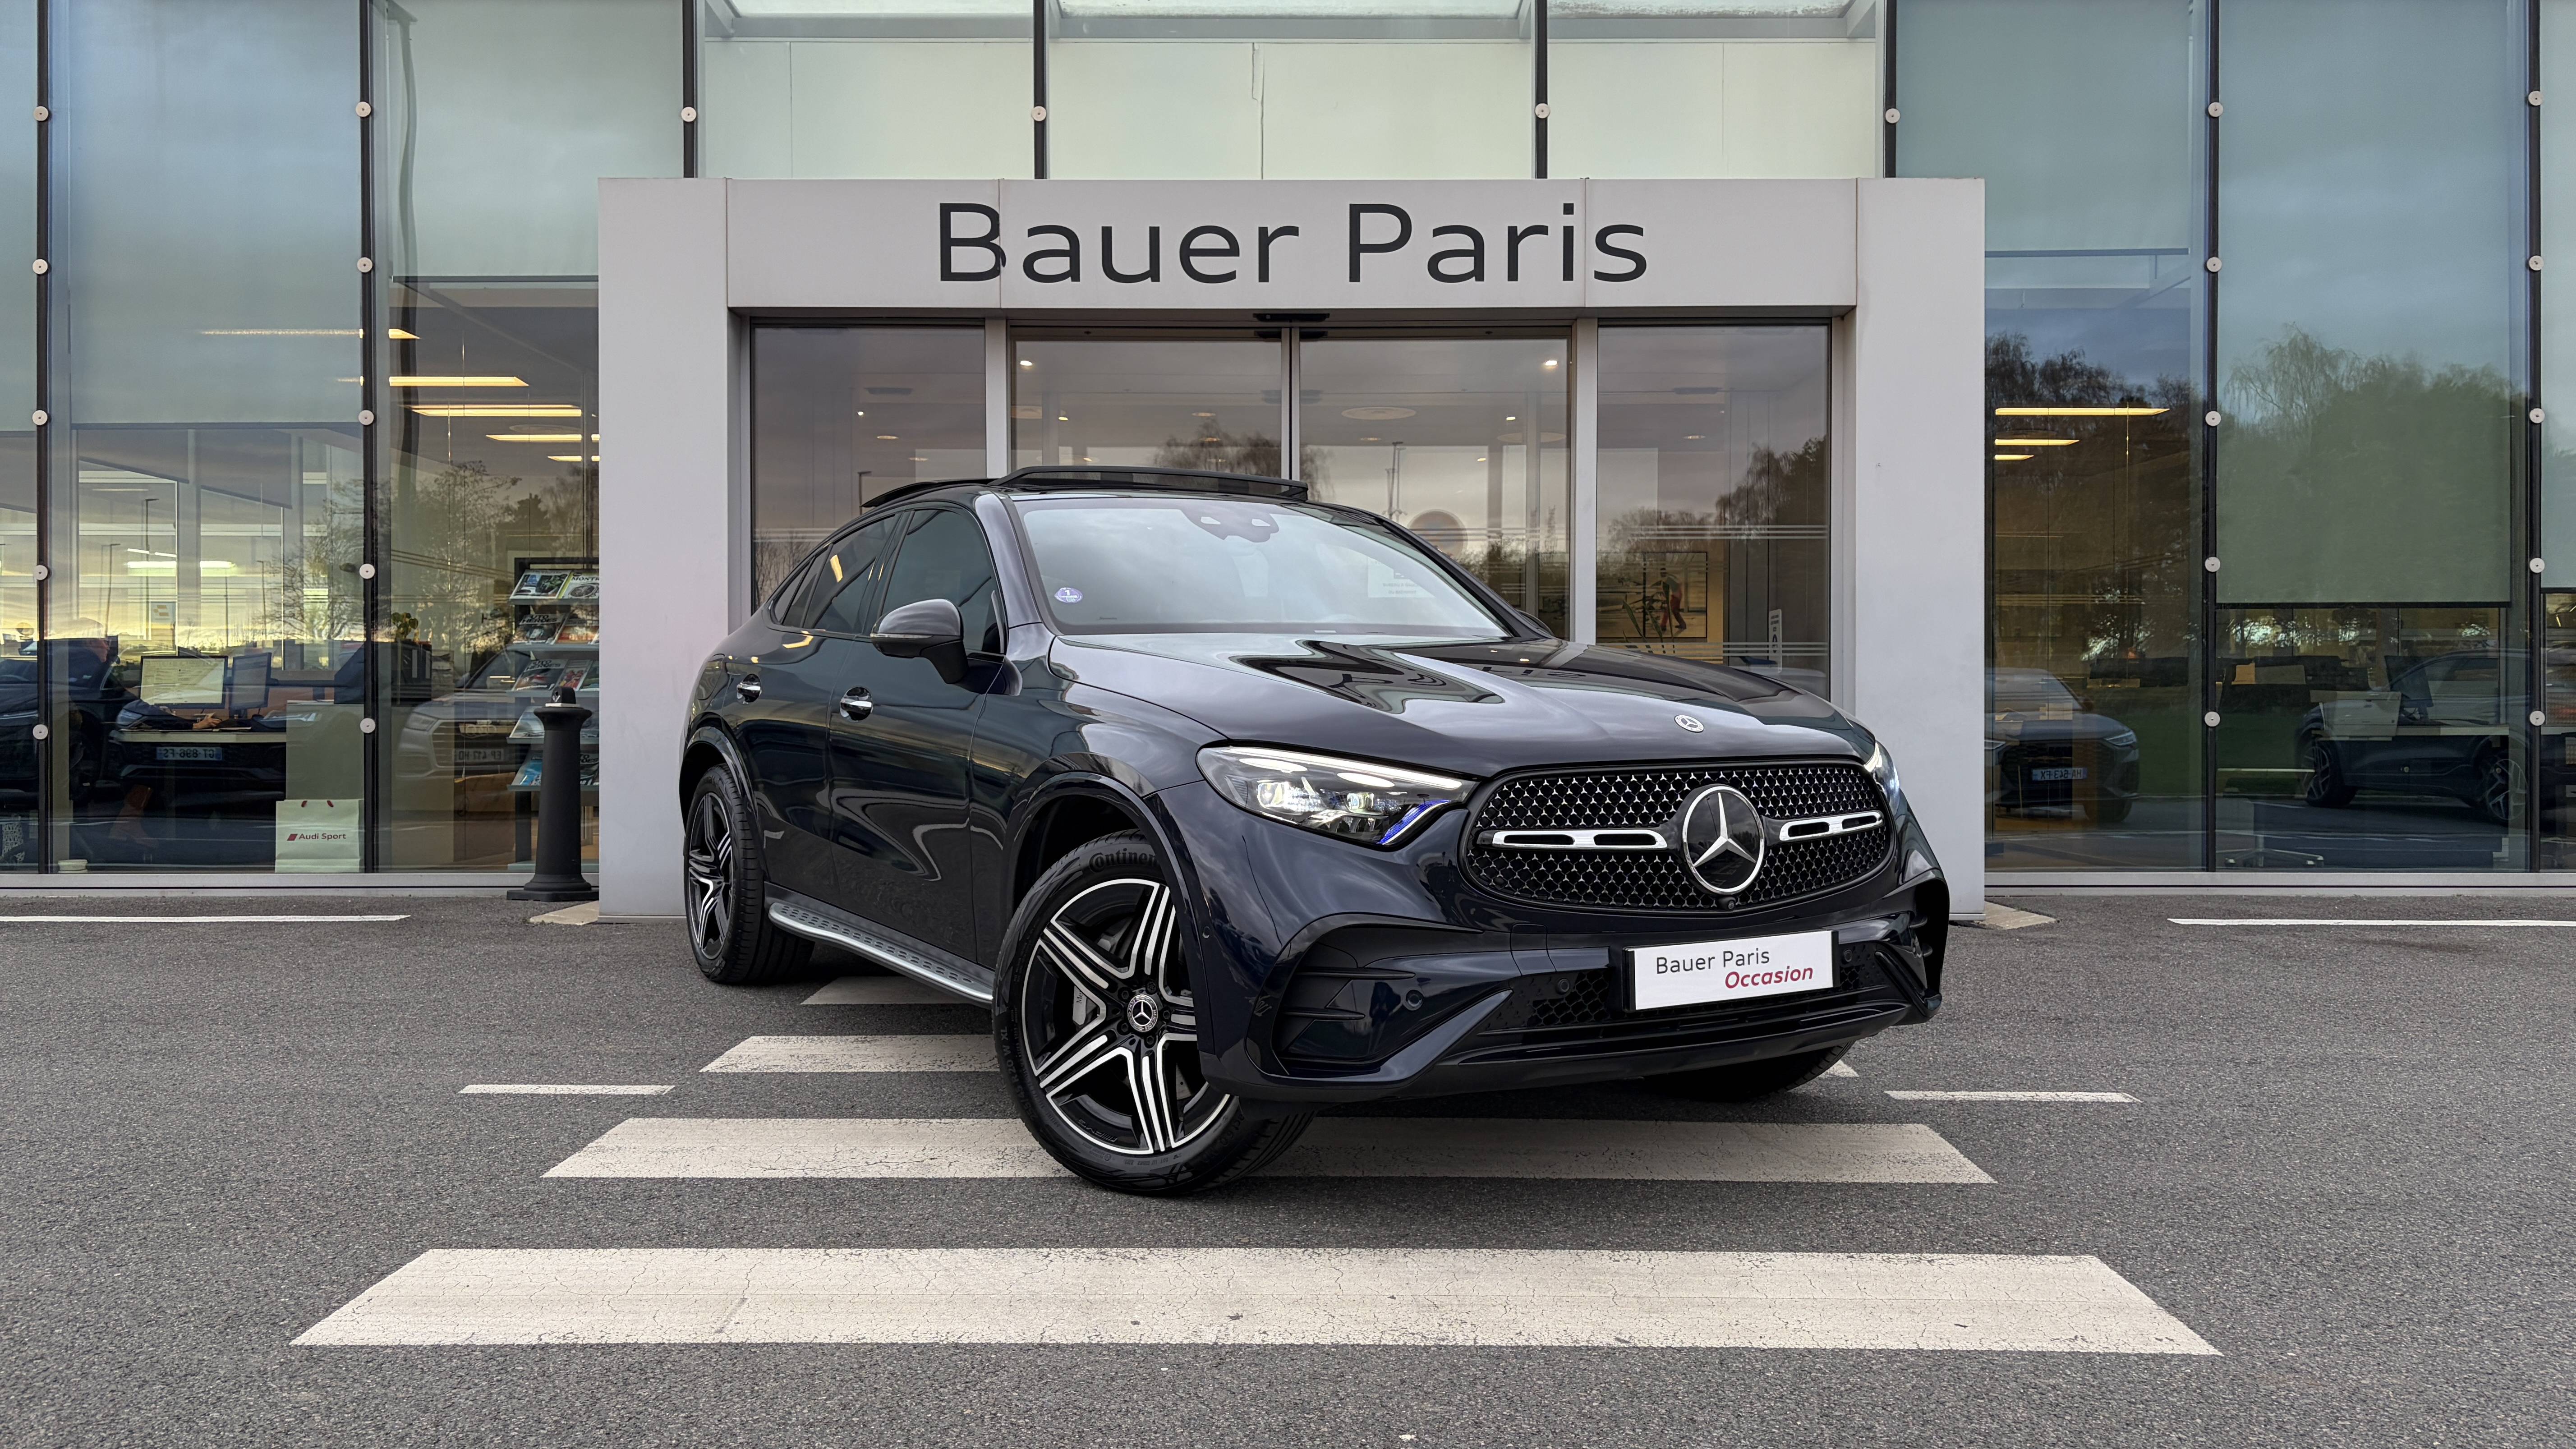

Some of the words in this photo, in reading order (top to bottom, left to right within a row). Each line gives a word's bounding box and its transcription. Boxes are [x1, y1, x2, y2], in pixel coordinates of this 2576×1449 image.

[940, 202, 1299, 284] Bauer
[1349, 202, 1647, 283] Paris
[1089, 848, 1159, 873] Continen
[1656, 955, 1716, 974] Bauer
[1723, 948, 1770, 968] Paris
[1725, 965, 1813, 989] Occasion
[1000, 1026, 1009, 1040] XL
